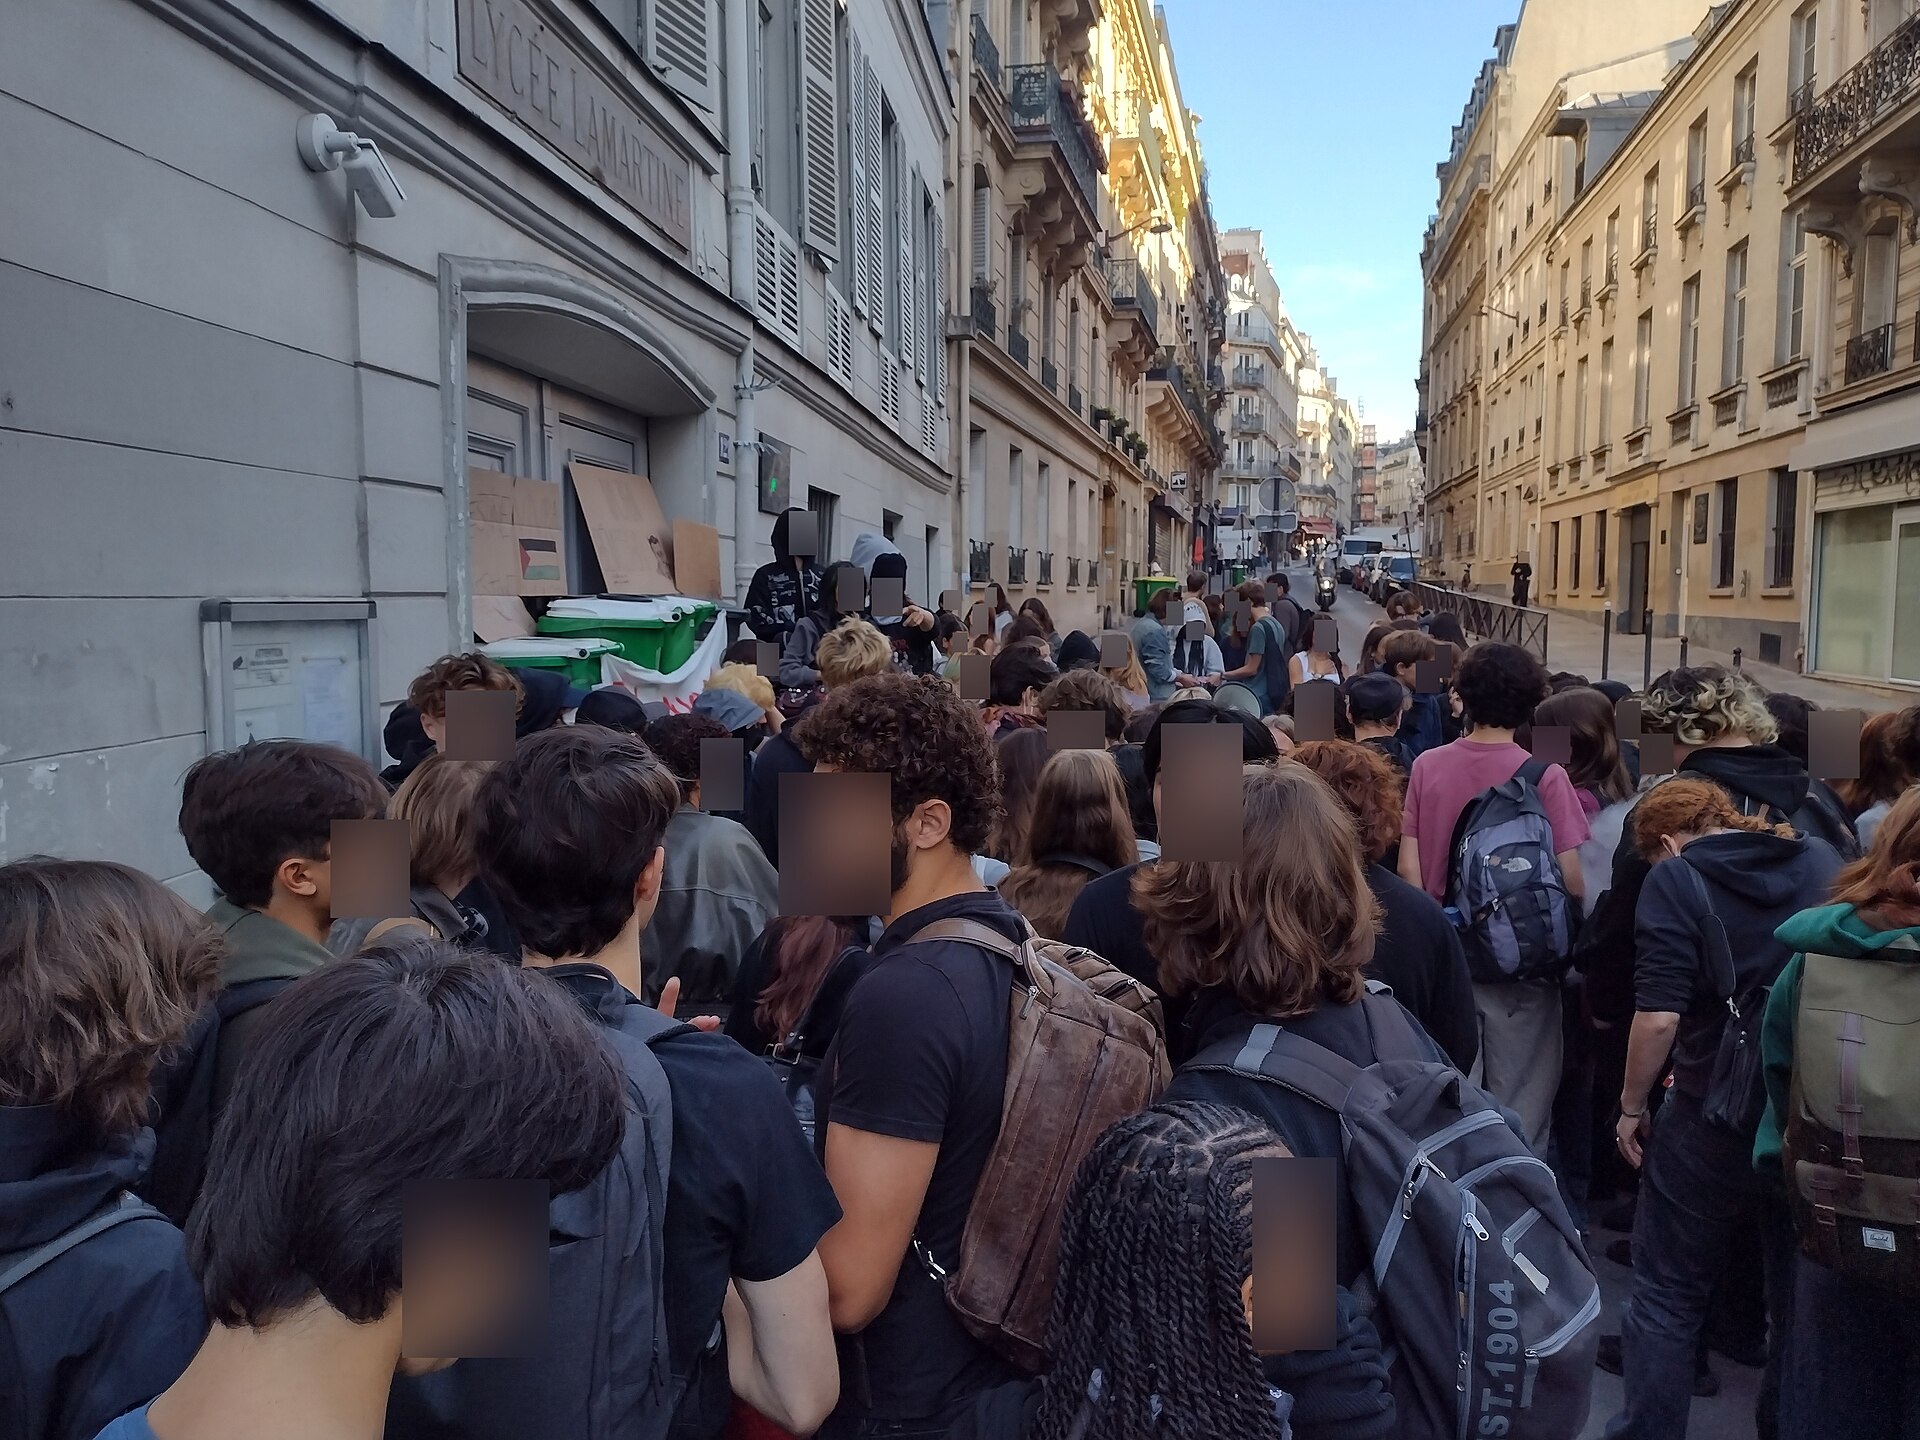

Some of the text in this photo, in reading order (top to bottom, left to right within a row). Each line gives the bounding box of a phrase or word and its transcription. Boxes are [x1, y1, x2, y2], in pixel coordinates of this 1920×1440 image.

[470, 0, 685, 229] LYCÉE LAMARTINE
[1477, 1280, 1519, 1440] ST.1904
